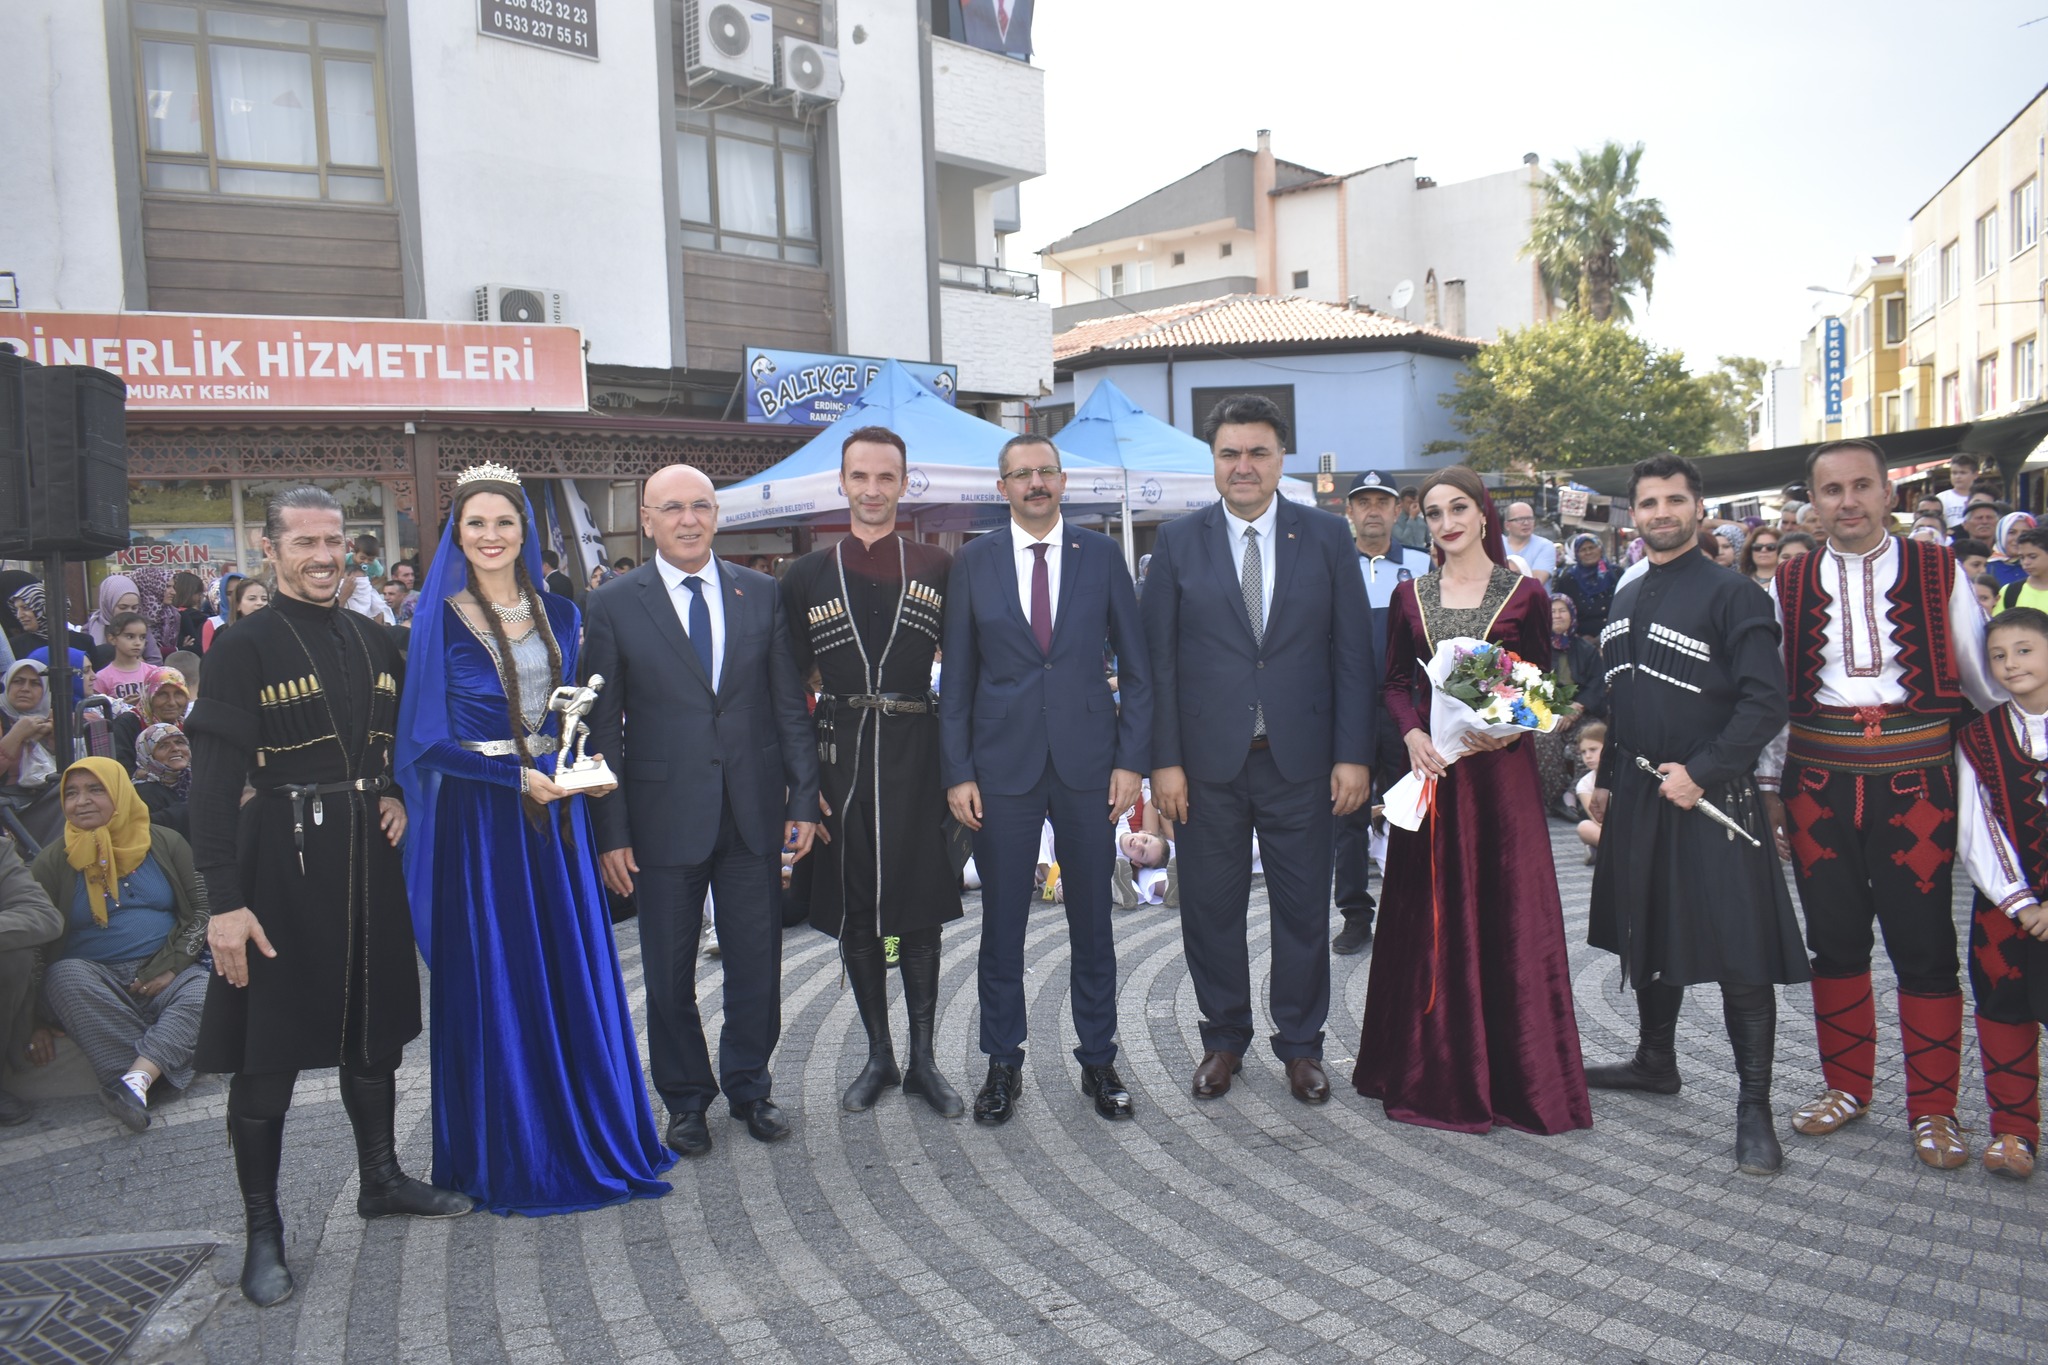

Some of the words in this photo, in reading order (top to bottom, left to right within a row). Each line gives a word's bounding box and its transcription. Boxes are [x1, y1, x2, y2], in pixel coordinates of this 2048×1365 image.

[530, 0, 553, 15] 432
[556, 2, 570, 20] 32
[573, 7, 588, 24] 23
[494, 11, 502, 27] 0
[505, 13, 528, 33] 533
[532, 20, 553, 39] 237
[557, 26, 572, 43] 55
[575, 30, 588, 47] 51
[258, 331, 534, 381] HİZMETLERİ
[127, 384, 194, 400] MURAT
[200, 381, 269, 400] KESKİN
[759, 366, 856, 416] BALIKÇI
[117, 540, 209, 566] KESKİN
